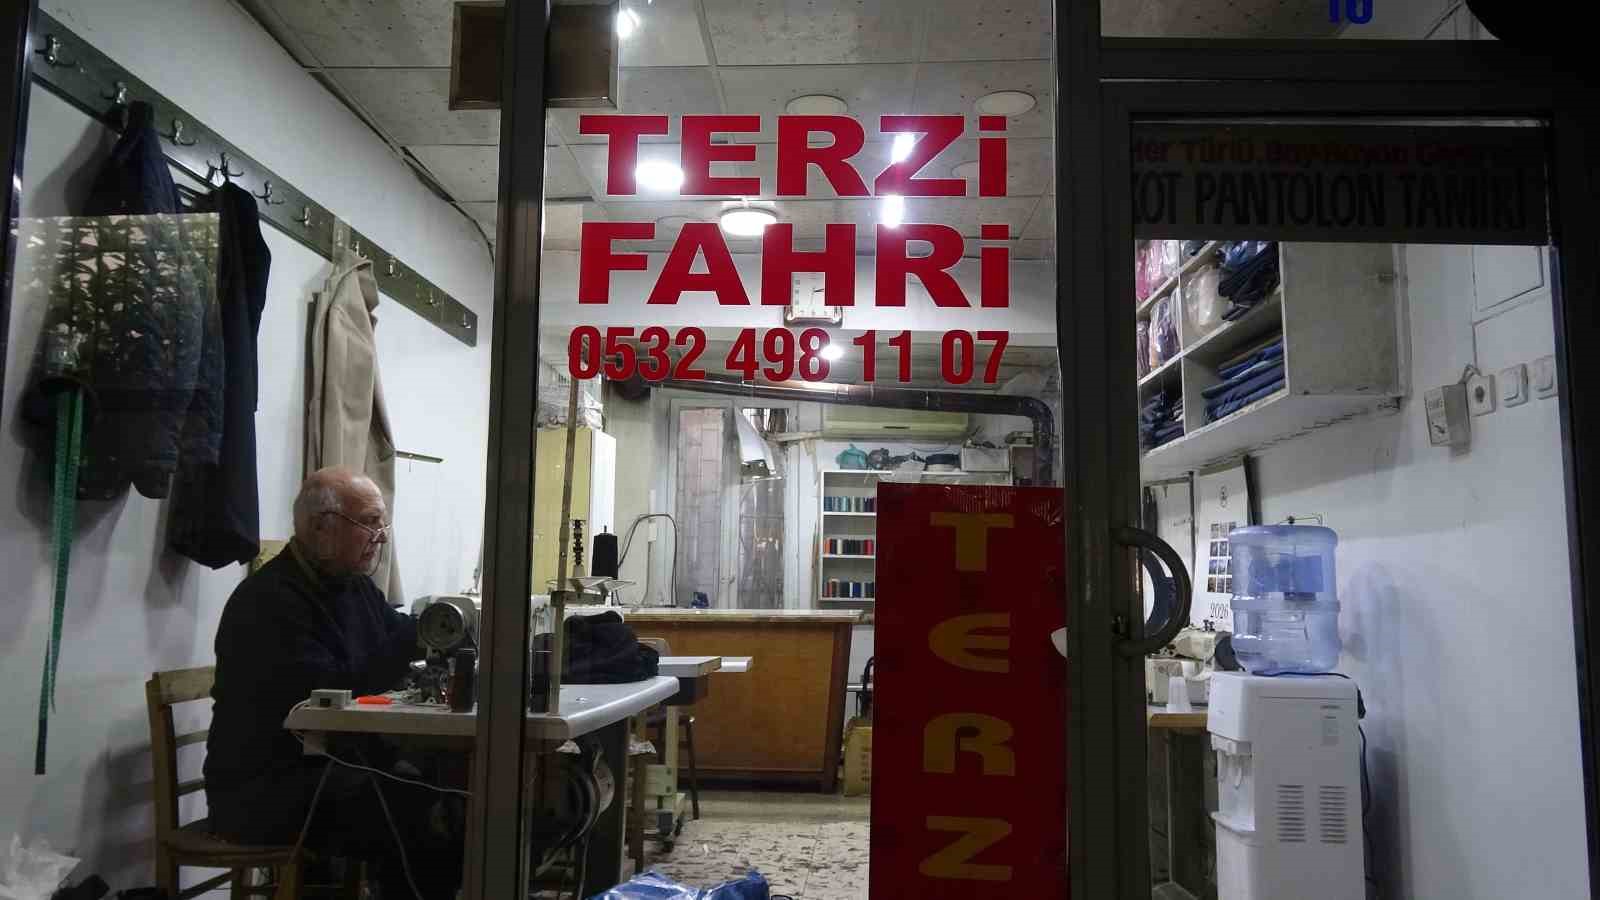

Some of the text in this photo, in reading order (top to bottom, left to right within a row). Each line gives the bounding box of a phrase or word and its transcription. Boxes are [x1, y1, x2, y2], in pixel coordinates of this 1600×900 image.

[1195, 171, 1386, 228] PANTOLON
[569, 326, 1009, 384] 0532 498 11 07
